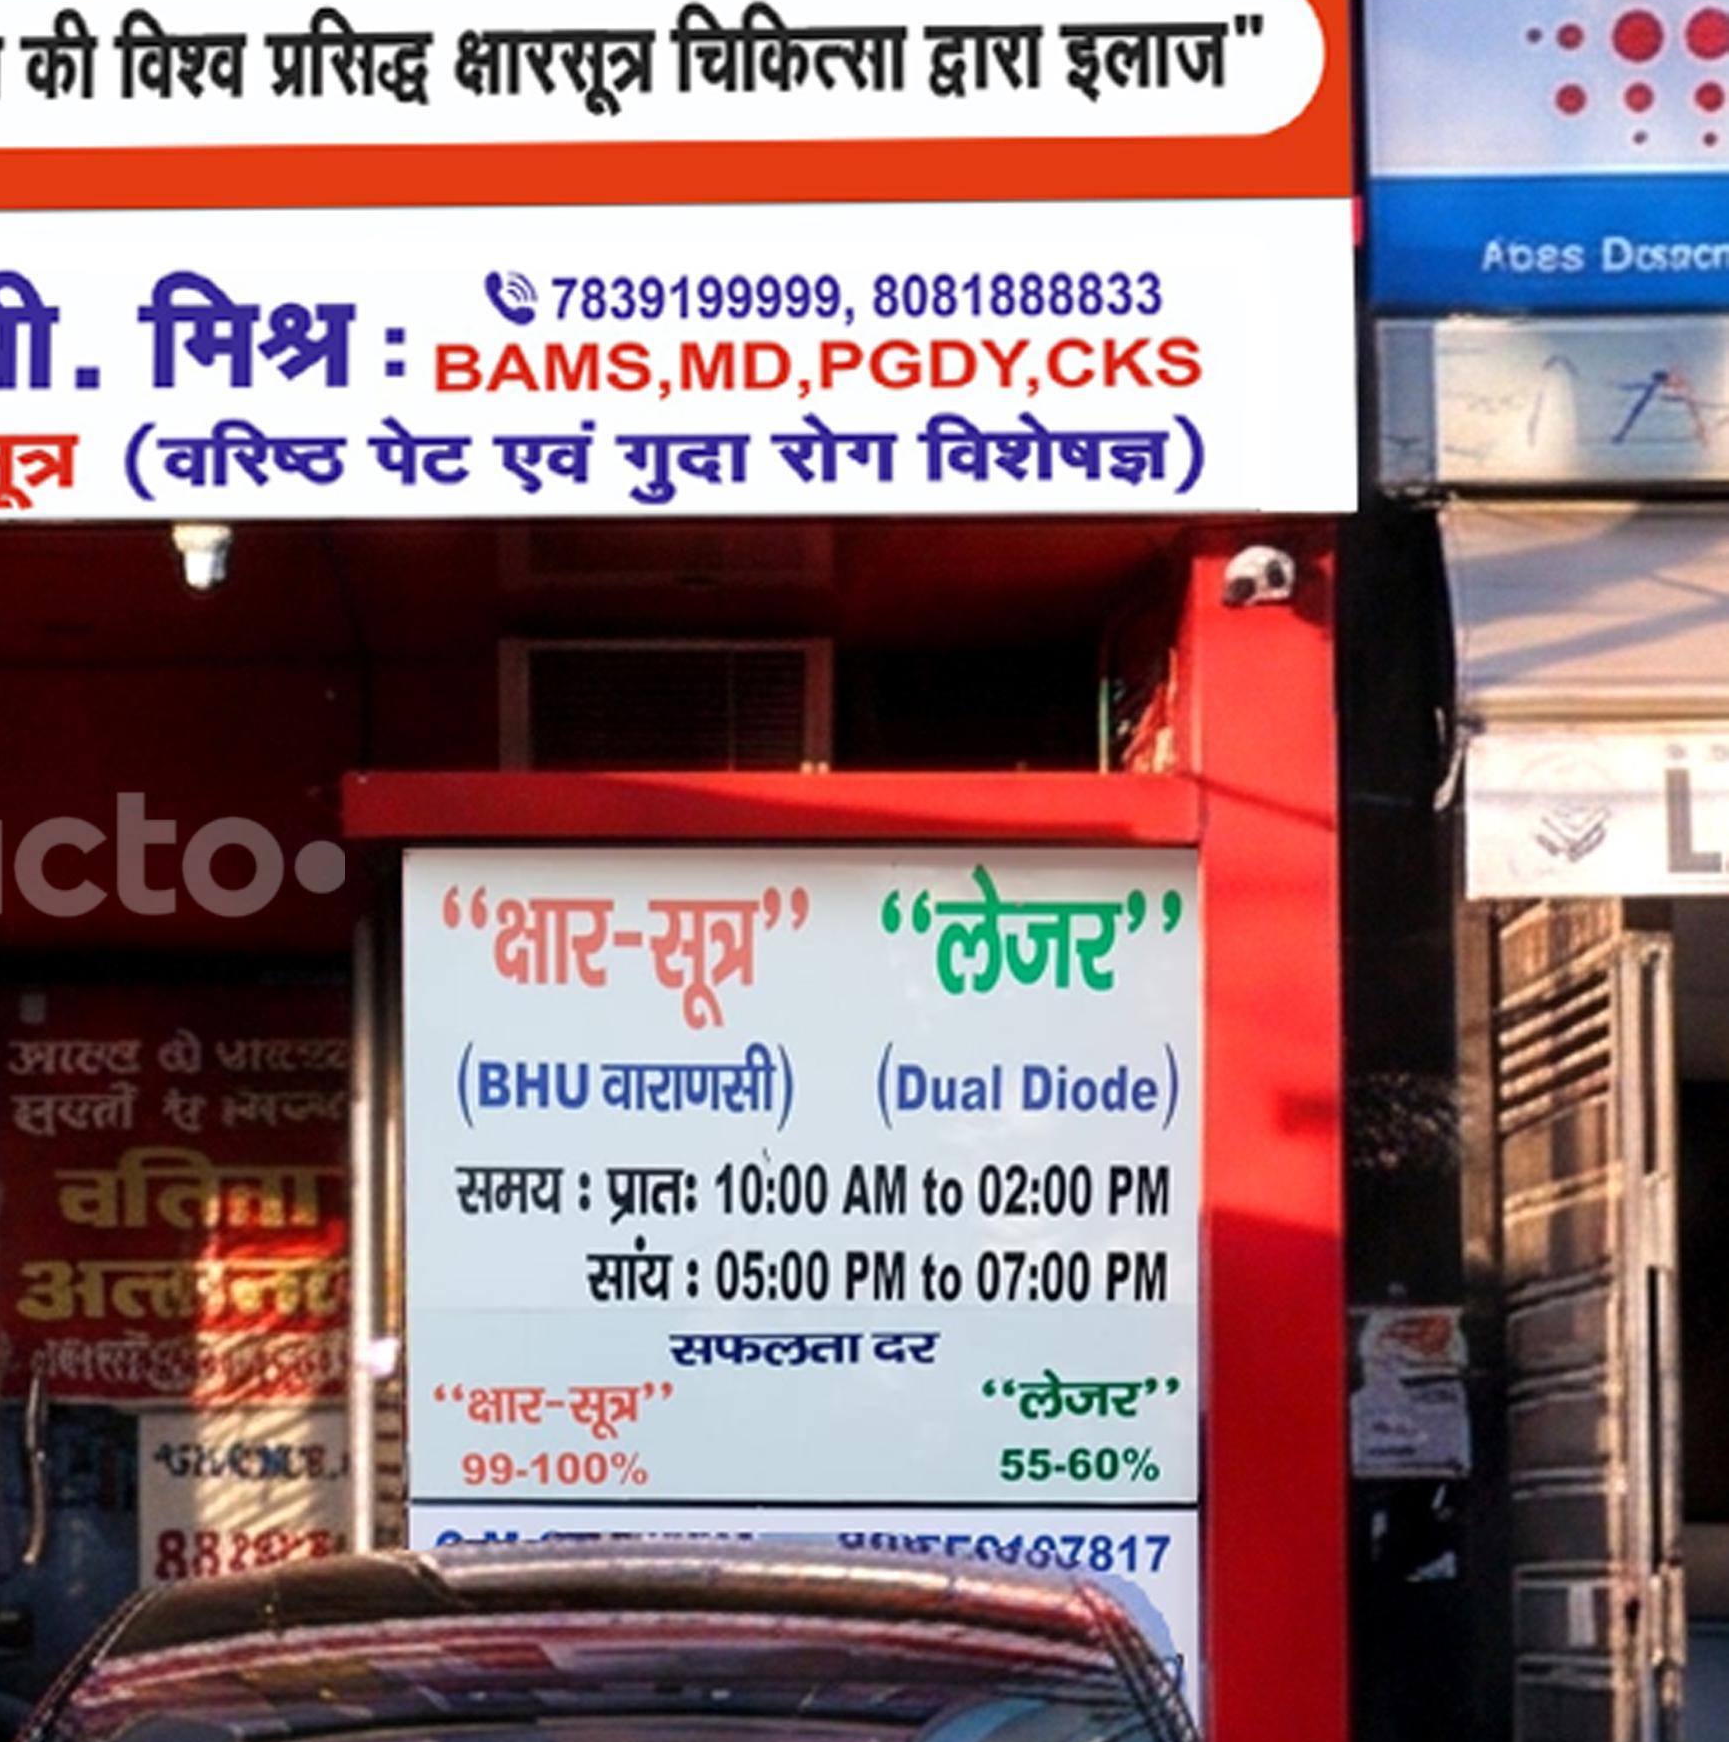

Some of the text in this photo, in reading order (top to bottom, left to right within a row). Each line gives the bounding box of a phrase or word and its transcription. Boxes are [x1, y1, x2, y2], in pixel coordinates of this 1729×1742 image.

[21, 9, 104, 100] की
[114, 7, 247, 100] विश्व
[265, 5, 434, 107] प्रसिद्ध
[454, 26, 655, 116] क्षारसूत्र
[671, 2, 908, 94] चिकित्सा
[924, 21, 1044, 97] द्वारा
[550, 271, 1165, 326] 7839199999, 8081888833
[432, 335, 1204, 400] BAMS,MD,PGDY,CKS
[123, 419, 346, 502] (वरिष्ठ
[368, 415, 472, 486] पेट
[493, 420, 597, 494] एवं
[617, 432, 750, 506] गुदा
[772, 415, 897, 486] रोग
[918, 412, 1207, 494] विशेषज्ञ)
[457, 1040, 591, 1130] (BHU
[600, 1041, 795, 1133] वाराणसी)
[877, 1042, 1180, 1130] (Dual Diode)
[455, 1162, 565, 1215] समय
[714, 1163, 828, 1216] 10:00
[842, 1164, 908, 1216] AM
[922, 1167, 965, 1216] to
[977, 1163, 1098, 1216] 02:00
[1107, 1163, 1170, 1216] PM
[586, 1236, 672, 1303] सांय
[714, 1249, 830, 1303] 05:00
[844, 1251, 907, 1302] PM
[921, 1253, 963, 1303] to
[976, 1251, 1090, 1303] 07:00
[1106, 1251, 1169, 1303] PM
[670, 1331, 941, 1367] सफलता दर
[460, 1450, 649, 1487] 99-100%
[999, 1446, 1161, 1484] 55-60%
